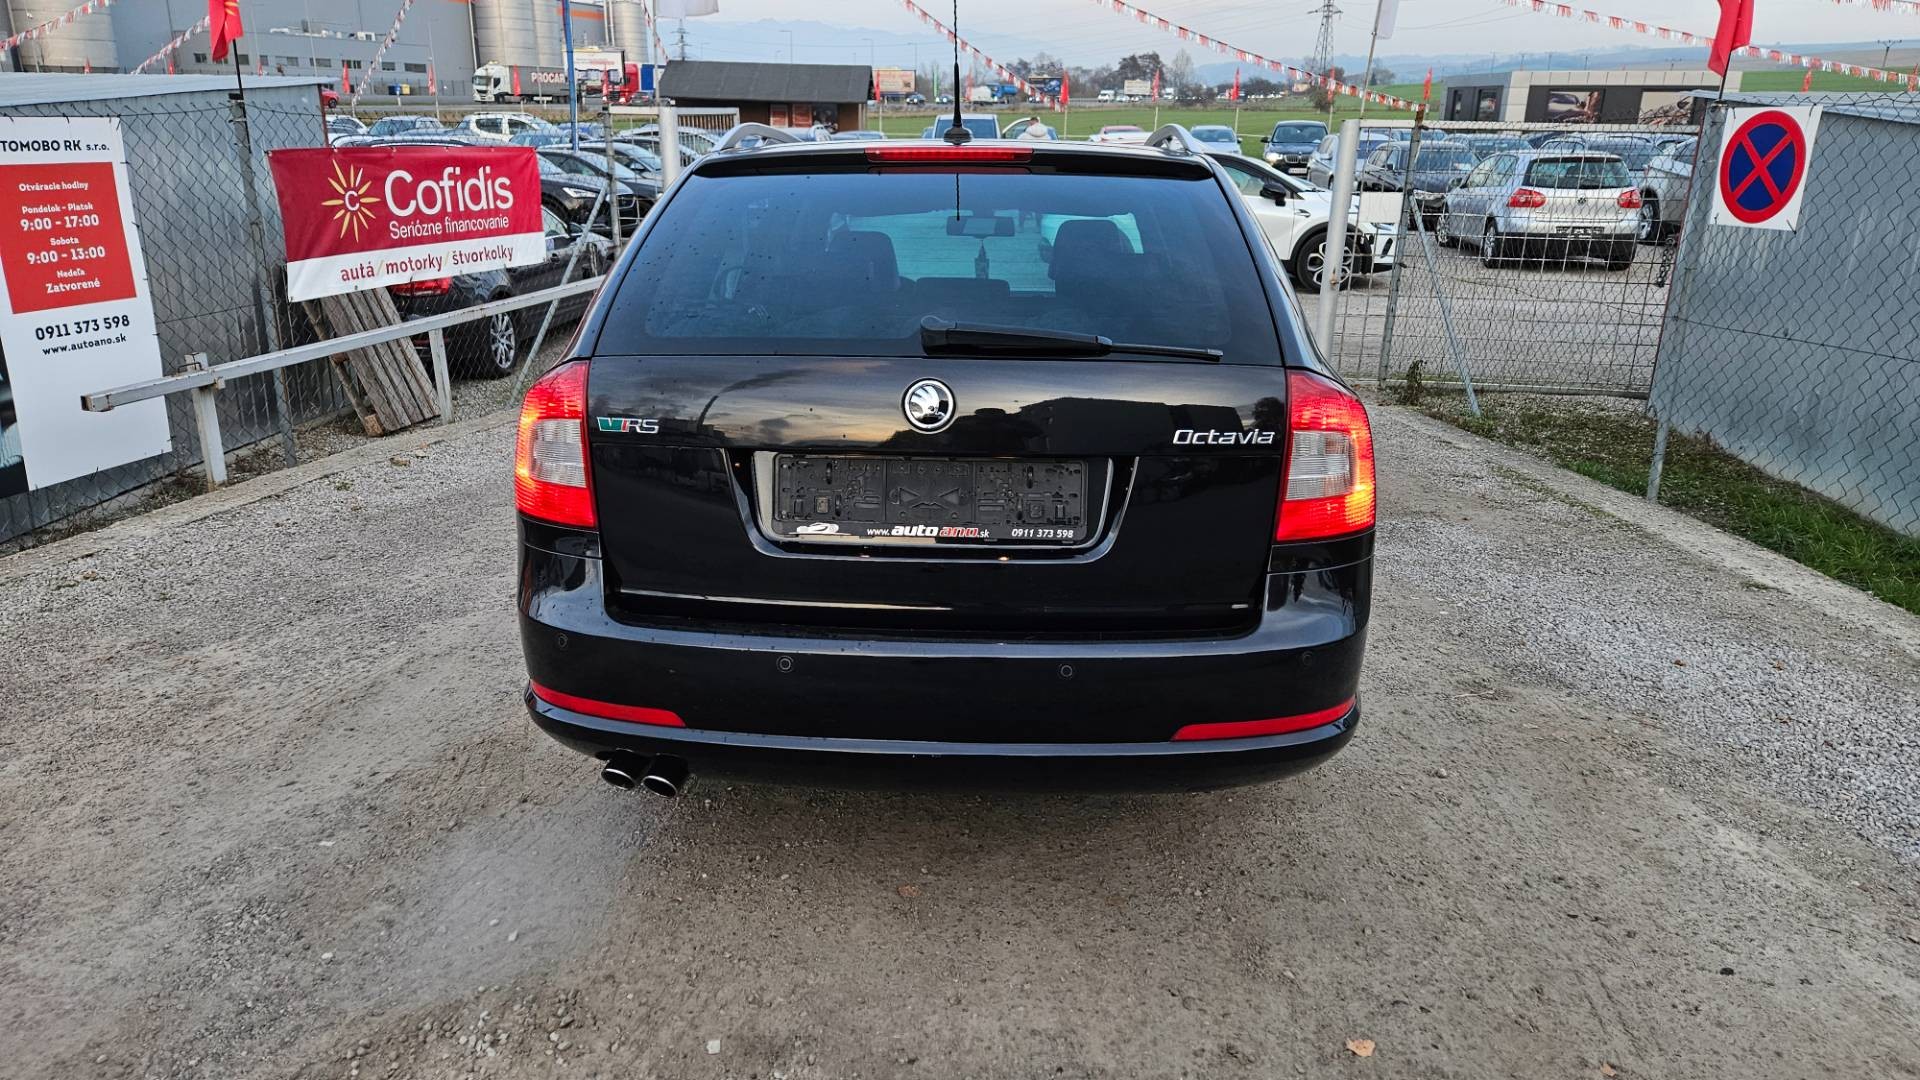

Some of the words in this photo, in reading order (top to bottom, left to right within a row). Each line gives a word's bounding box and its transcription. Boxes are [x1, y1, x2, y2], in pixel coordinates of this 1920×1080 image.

[531, 72, 566, 84] PROCAR
[0, 140, 61, 152] TOMOBO
[63, 140, 82, 151] RK
[86, 143, 110, 151] s.r.o.
[19, 182, 61, 192] Otváracie
[61, 181, 89, 191] hodiny
[384, 166, 514, 217] Cofidis
[21, 204, 61, 214] Pondelok
[67, 202, 94, 211] Piatok
[20, 217, 52, 231] 9:00
[64, 214, 100, 228] 17:00
[389, 220, 443, 240] Seriózne
[445, 215, 510, 234] financovanie
[50, 237, 80, 246] Sobota
[27, 250, 58, 265] 9:00
[70, 246, 106, 260] 13:00
[56, 268, 86, 278] Nedeľa
[46, 278, 101, 294] Zatvorené
[35, 323, 71, 341] 0911
[74, 319, 100, 335] 373
[103, 314, 130, 330] 598
[42, 333, 127, 356] www.autoano.sk
[1172, 428, 1276, 444] Octavia
[1011, 528, 1034, 538] 0911
[1036, 529, 1054, 538] 373
[1056, 529, 1074, 539] 598
